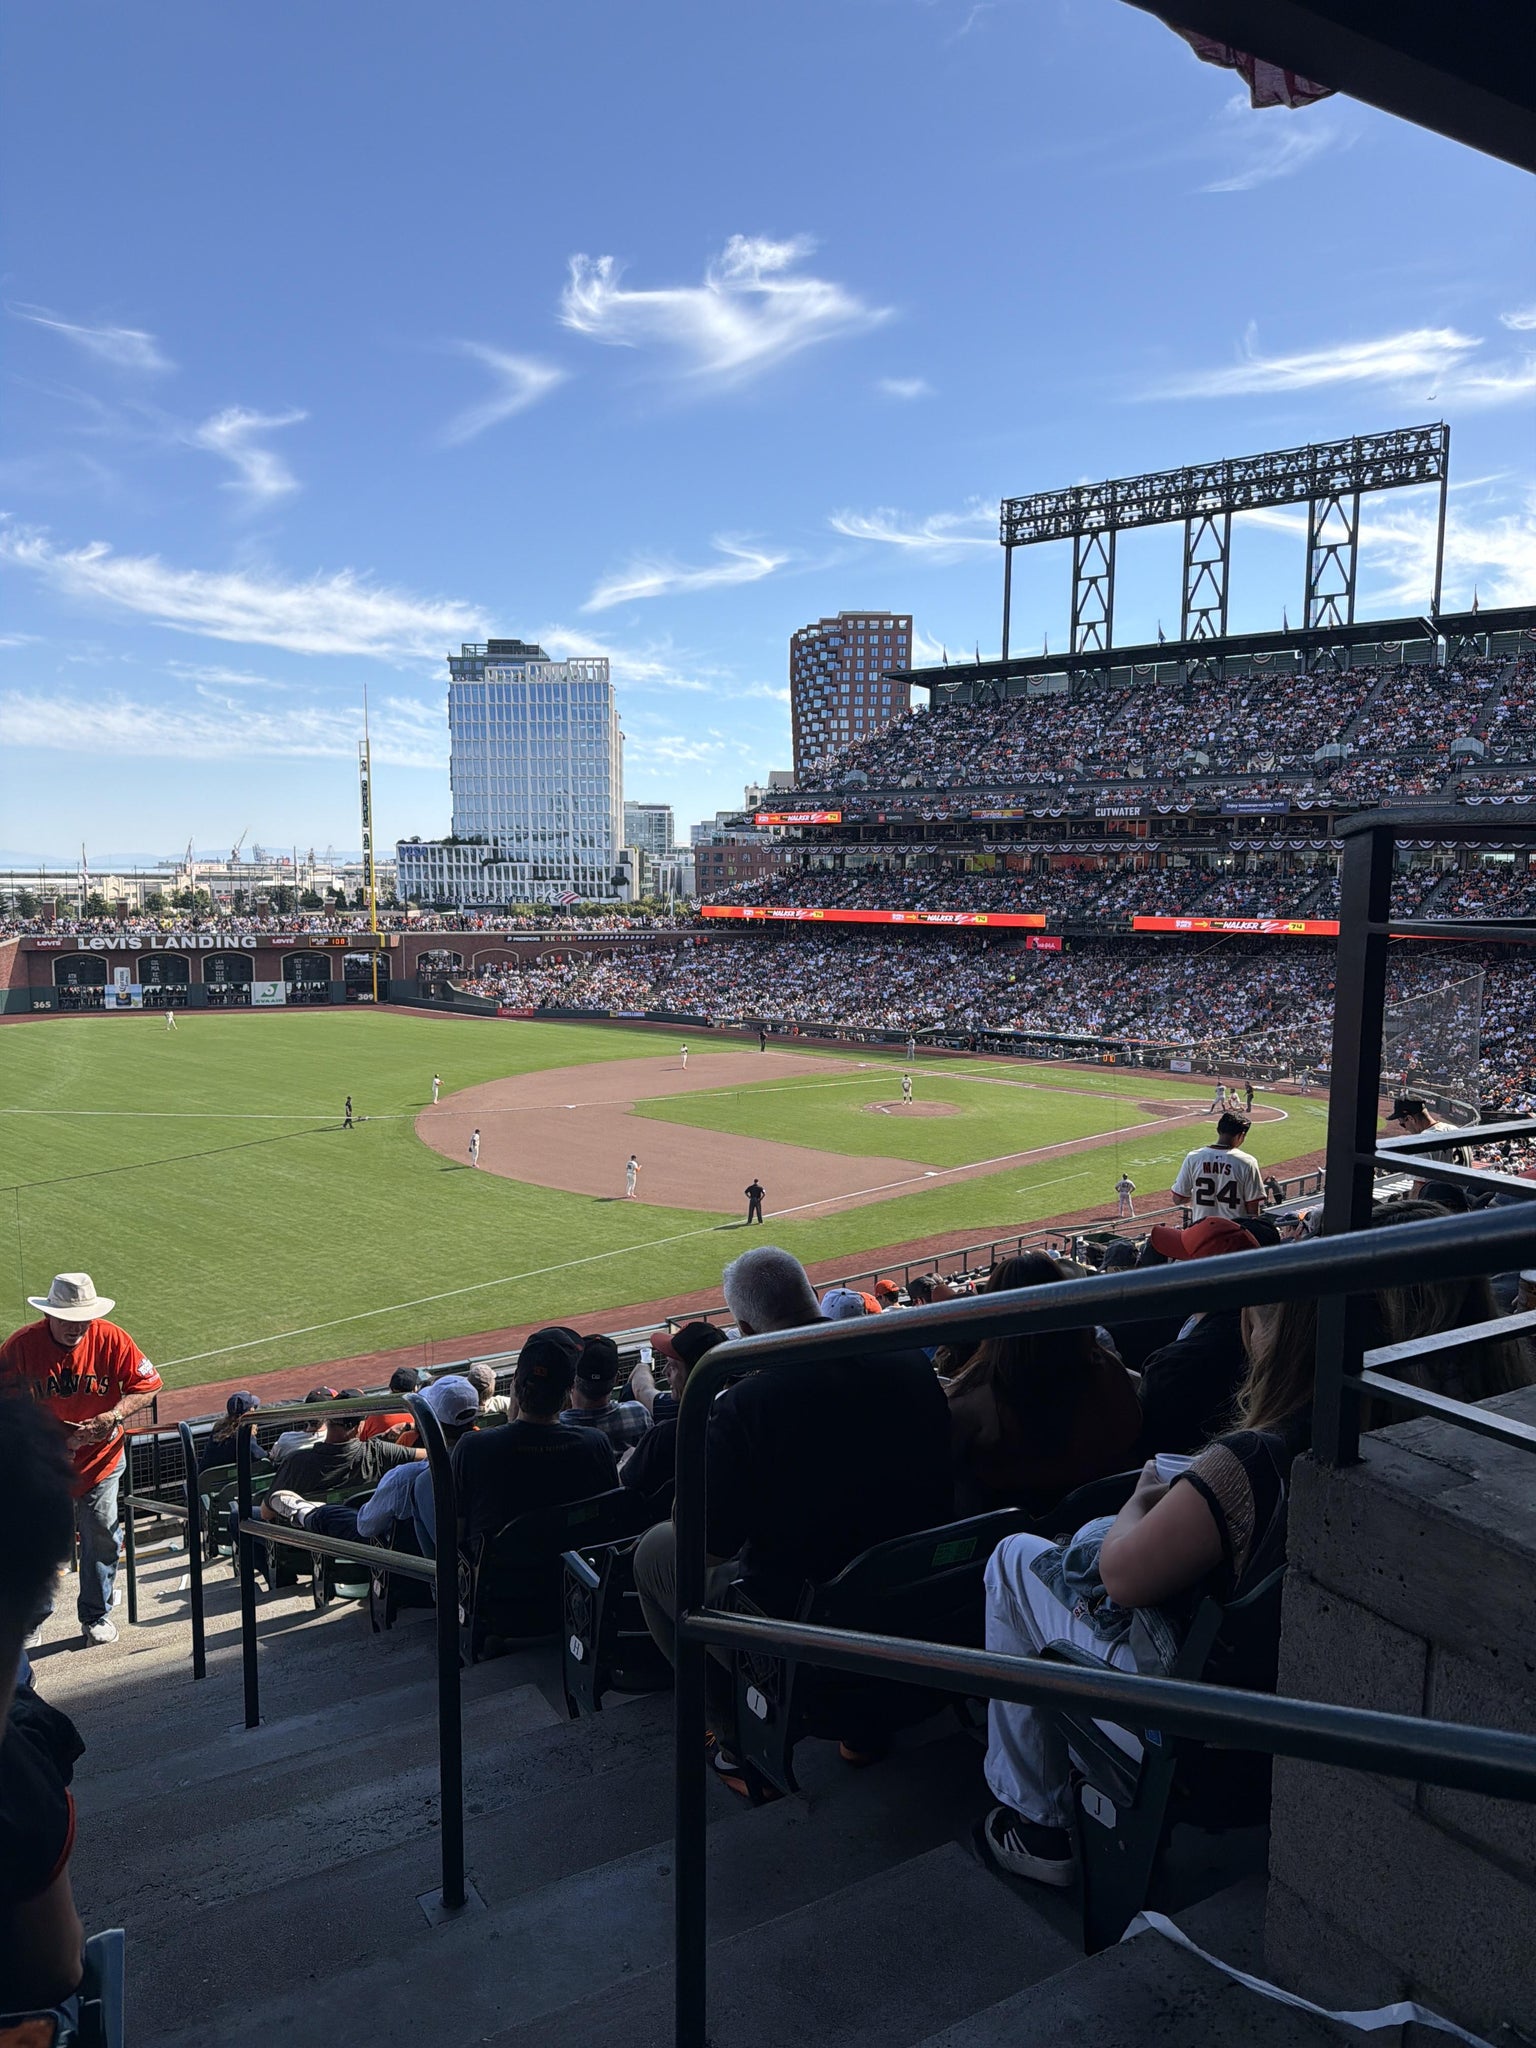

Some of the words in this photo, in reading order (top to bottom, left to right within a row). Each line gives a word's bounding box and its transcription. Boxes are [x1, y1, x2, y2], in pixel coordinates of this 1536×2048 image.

[1095, 807, 1141, 817] CUTWATER
[437, 896, 473, 904] BANK
[476, 896, 493, 904] OF
[496, 895, 551, 904] AMERICA
[927, 914, 954, 922] WALKER
[1222, 921, 1258, 930] WALKER
[150, 936, 257, 950] LANDING
[358, 993, 374, 1001] 309
[33, 1001, 51, 1009] 365
[1202, 1162, 1232, 1176] MAYS
[1195, 1177, 1241, 1210] 24
[31, 1374, 110, 1397] IANTS
[1094, 1795, 1103, 1816] J
